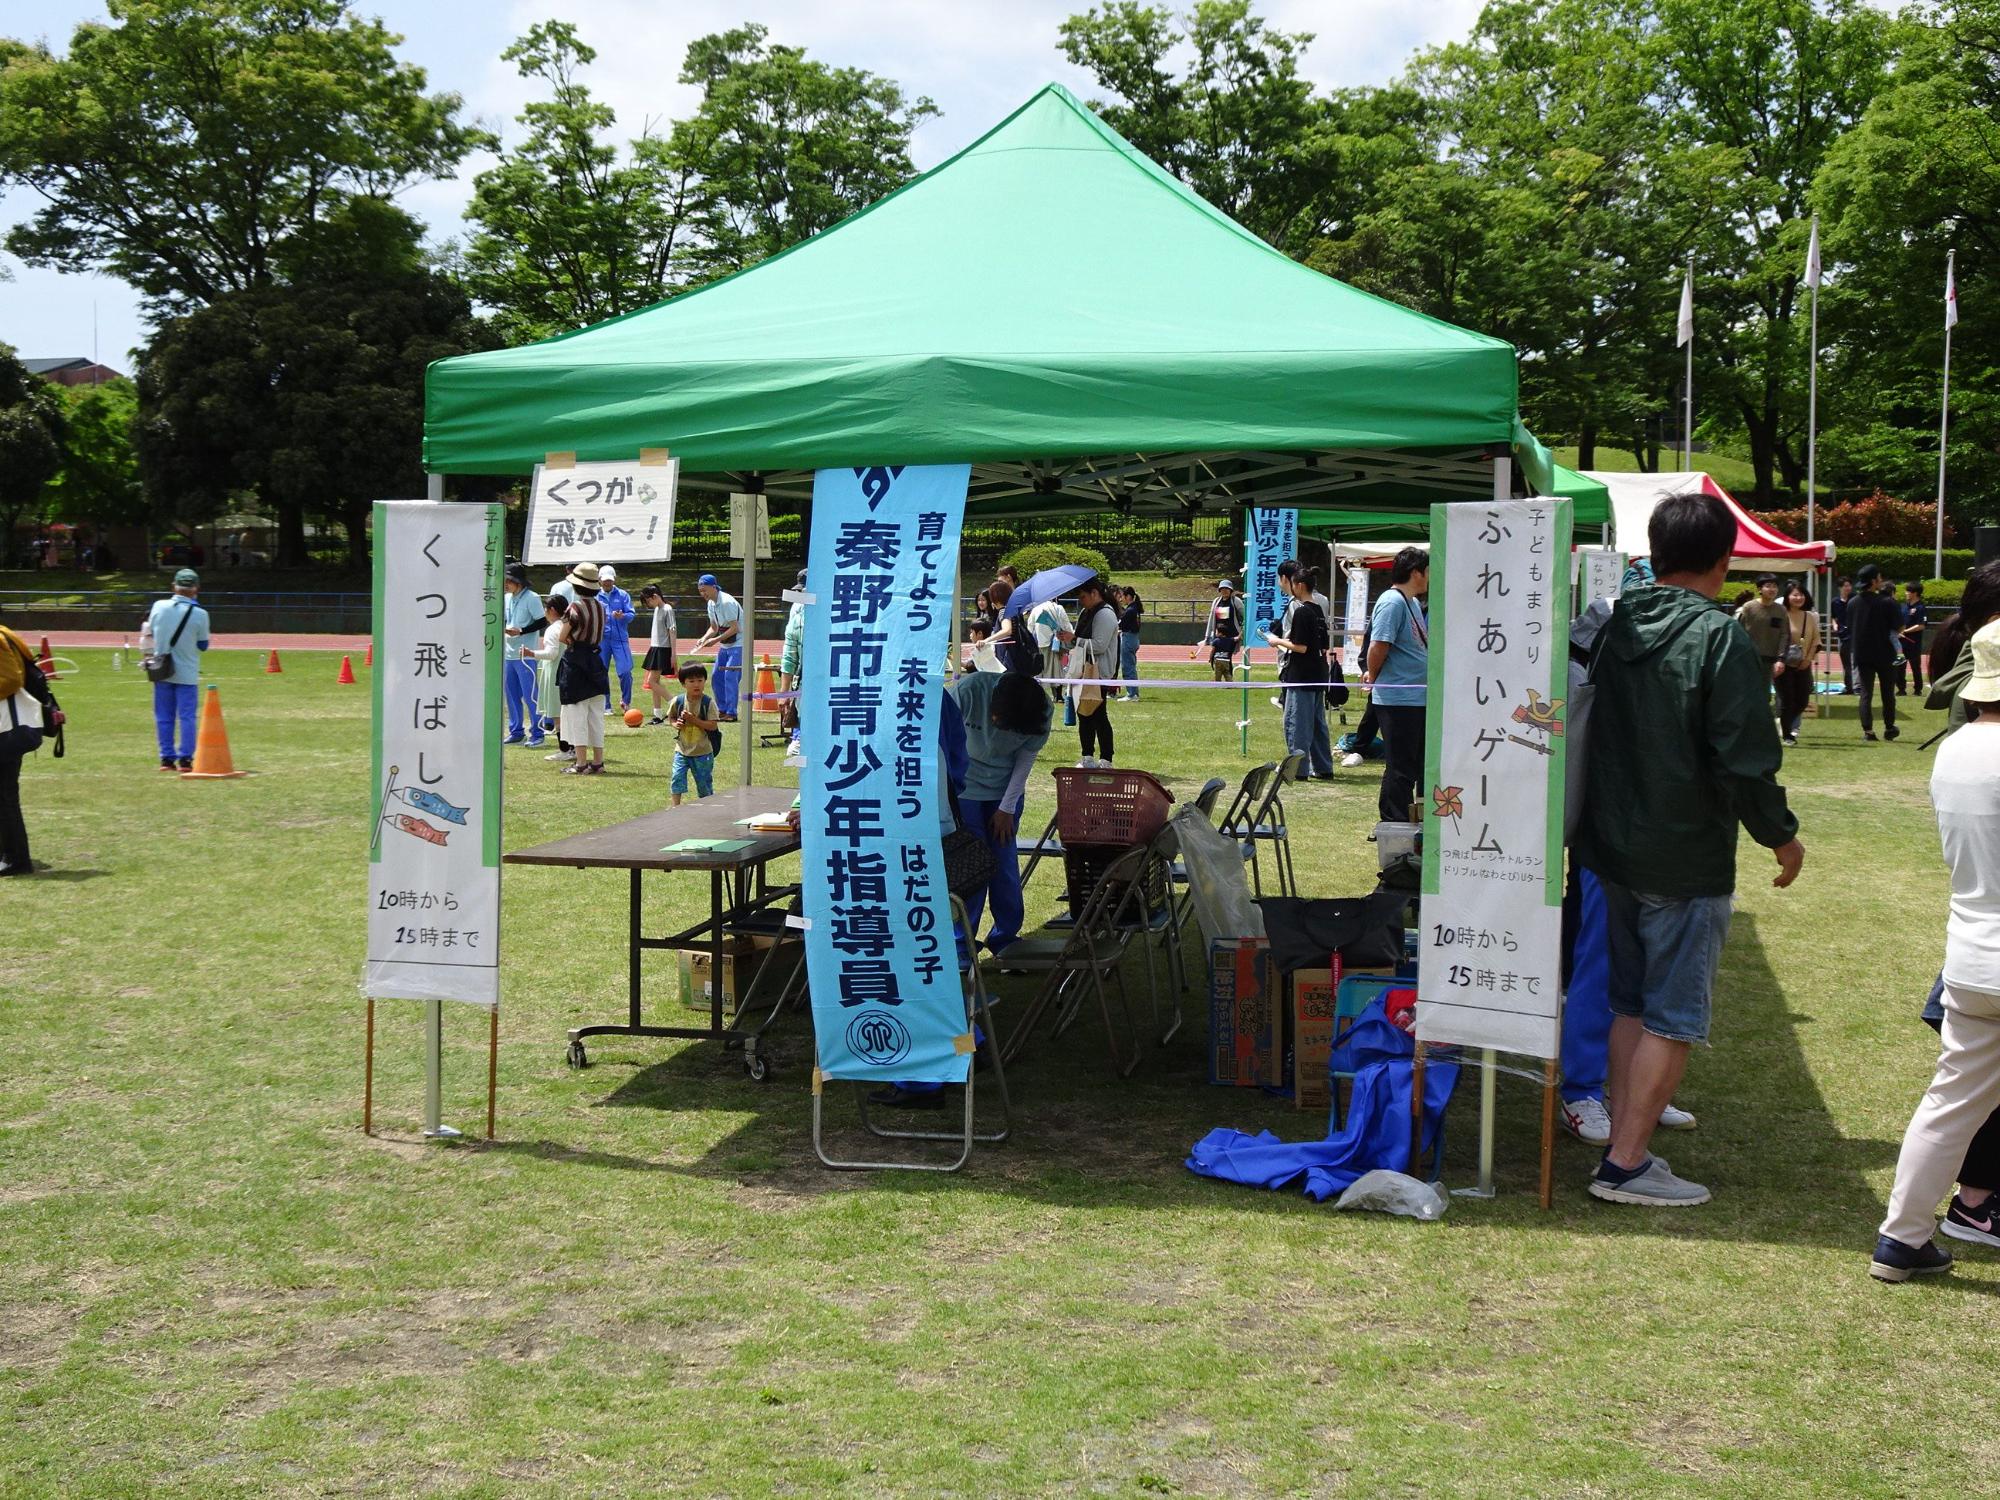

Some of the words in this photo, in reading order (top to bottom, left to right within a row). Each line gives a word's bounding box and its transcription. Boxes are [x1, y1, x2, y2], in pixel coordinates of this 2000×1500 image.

[546, 476, 634, 506] くつが
[481, 511, 499, 652] 子どもまつり
[906, 511, 948, 632] 育てよう
[1525, 508, 1546, 665] 子どもまつり
[413, 533, 448, 785] くつ飛ばし
[458, 648, 472, 666] と
[1472, 511, 1513, 855] ふれあいゲーム
[823, 519, 905, 1009] 秦野市青少年指導員
[895, 657, 929, 819] 未来を担う
[378, 889, 460, 912] 10時から
[394, 926, 480, 949] 15時まで
[900, 844, 943, 985] はだのっ子
[1432, 923, 1519, 952] 10時から
[1447, 965, 1541, 995] 15時まで
